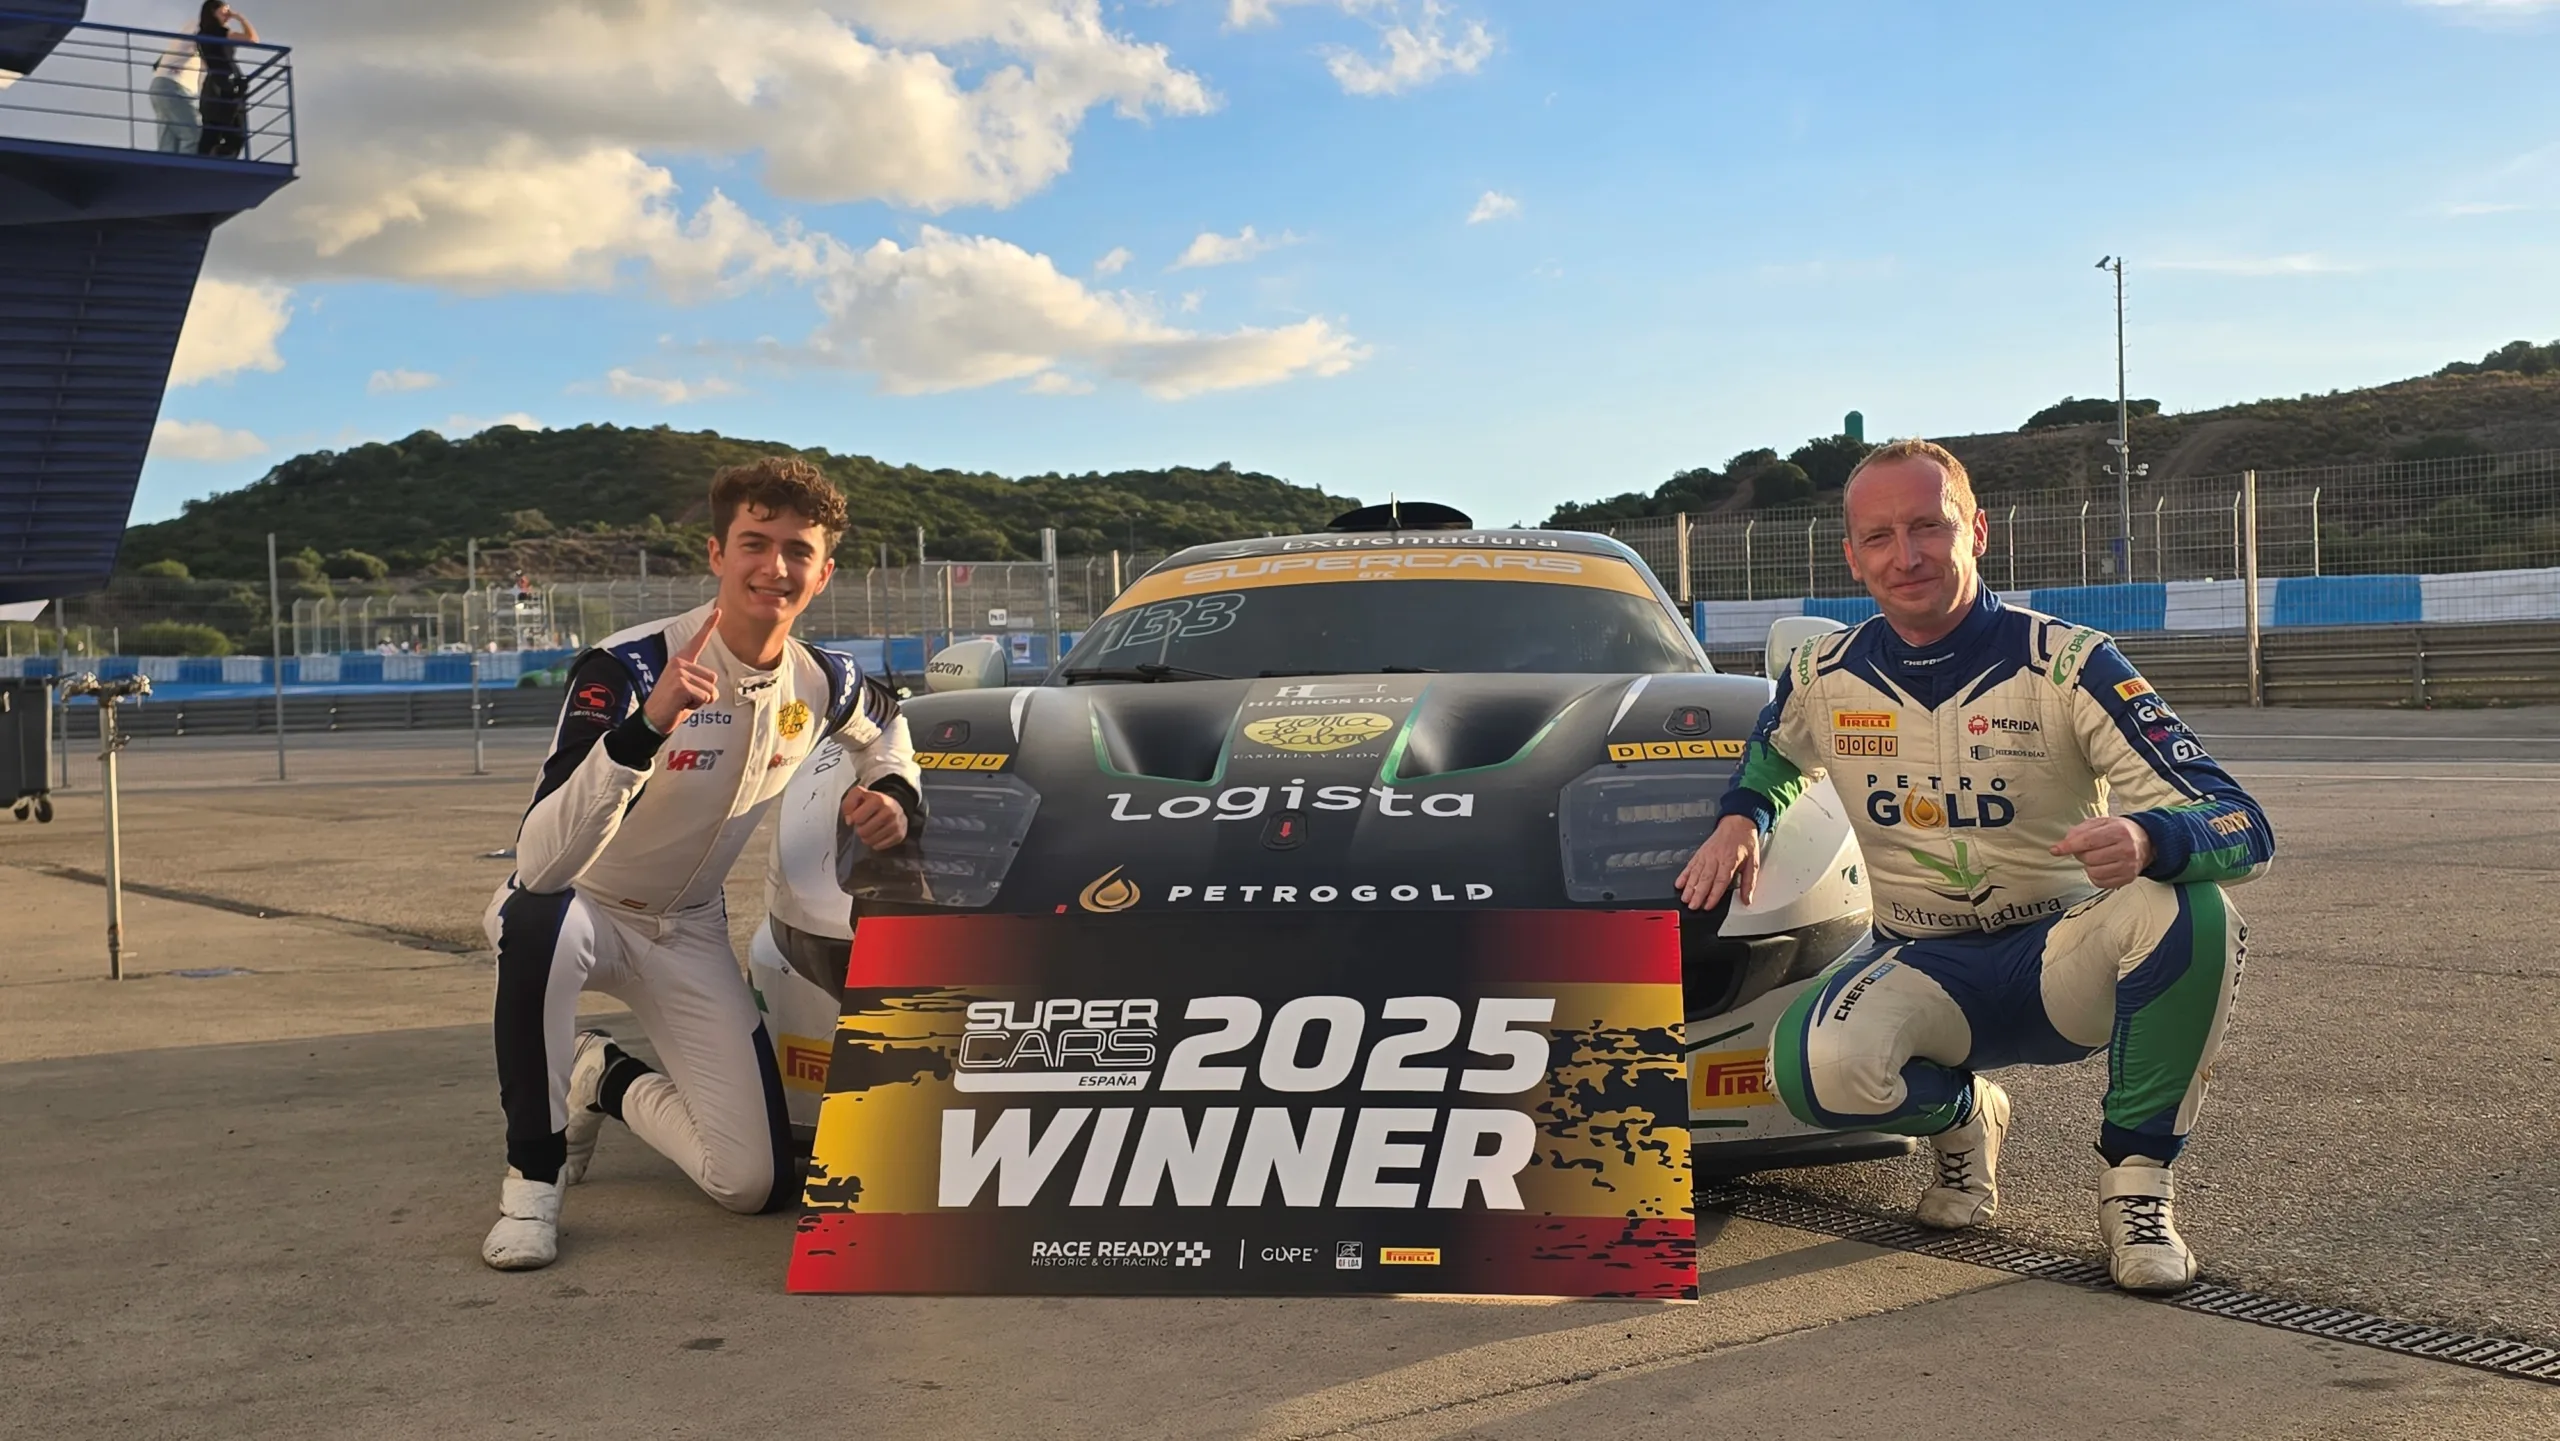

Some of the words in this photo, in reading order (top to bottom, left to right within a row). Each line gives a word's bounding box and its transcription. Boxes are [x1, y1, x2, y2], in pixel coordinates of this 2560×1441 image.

[1283, 534, 1558, 550] Extremadura
[1182, 554, 1582, 585] SUPERCARS
[1098, 593, 1245, 655] 133
[1248, 698, 1351, 707] HIERROS
[1840, 714, 1890, 727] PIRELLI
[1991, 717, 2040, 732] MÉRIDA
[1618, 743, 1740, 757] DOCU
[1838, 739, 1893, 752] DOCU
[917, 755, 998, 766] OCU
[1867, 774, 2006, 791] PETRO
[1167, 883, 1493, 902] PETROGOLD
[1892, 898, 2062, 931] Extremadura
[965, 998, 1159, 1032] SUPER
[958, 1028, 1158, 1068] CARS
[1160, 995, 1556, 1093] 2025
[1078, 1073, 1137, 1087] ESPAÑA
[937, 1107, 1537, 1210] WINNER
[1032, 1241, 1092, 1257] RACE
[1098, 1241, 1174, 1257] READY
[1386, 1251, 1435, 1261] PIRELLI
[1031, 1257, 1088, 1266] HISTORIC
[1091, 1258, 1099, 1266] &
[1103, 1258, 1118, 1266] GT
[1122, 1258, 1168, 1266] RACING
